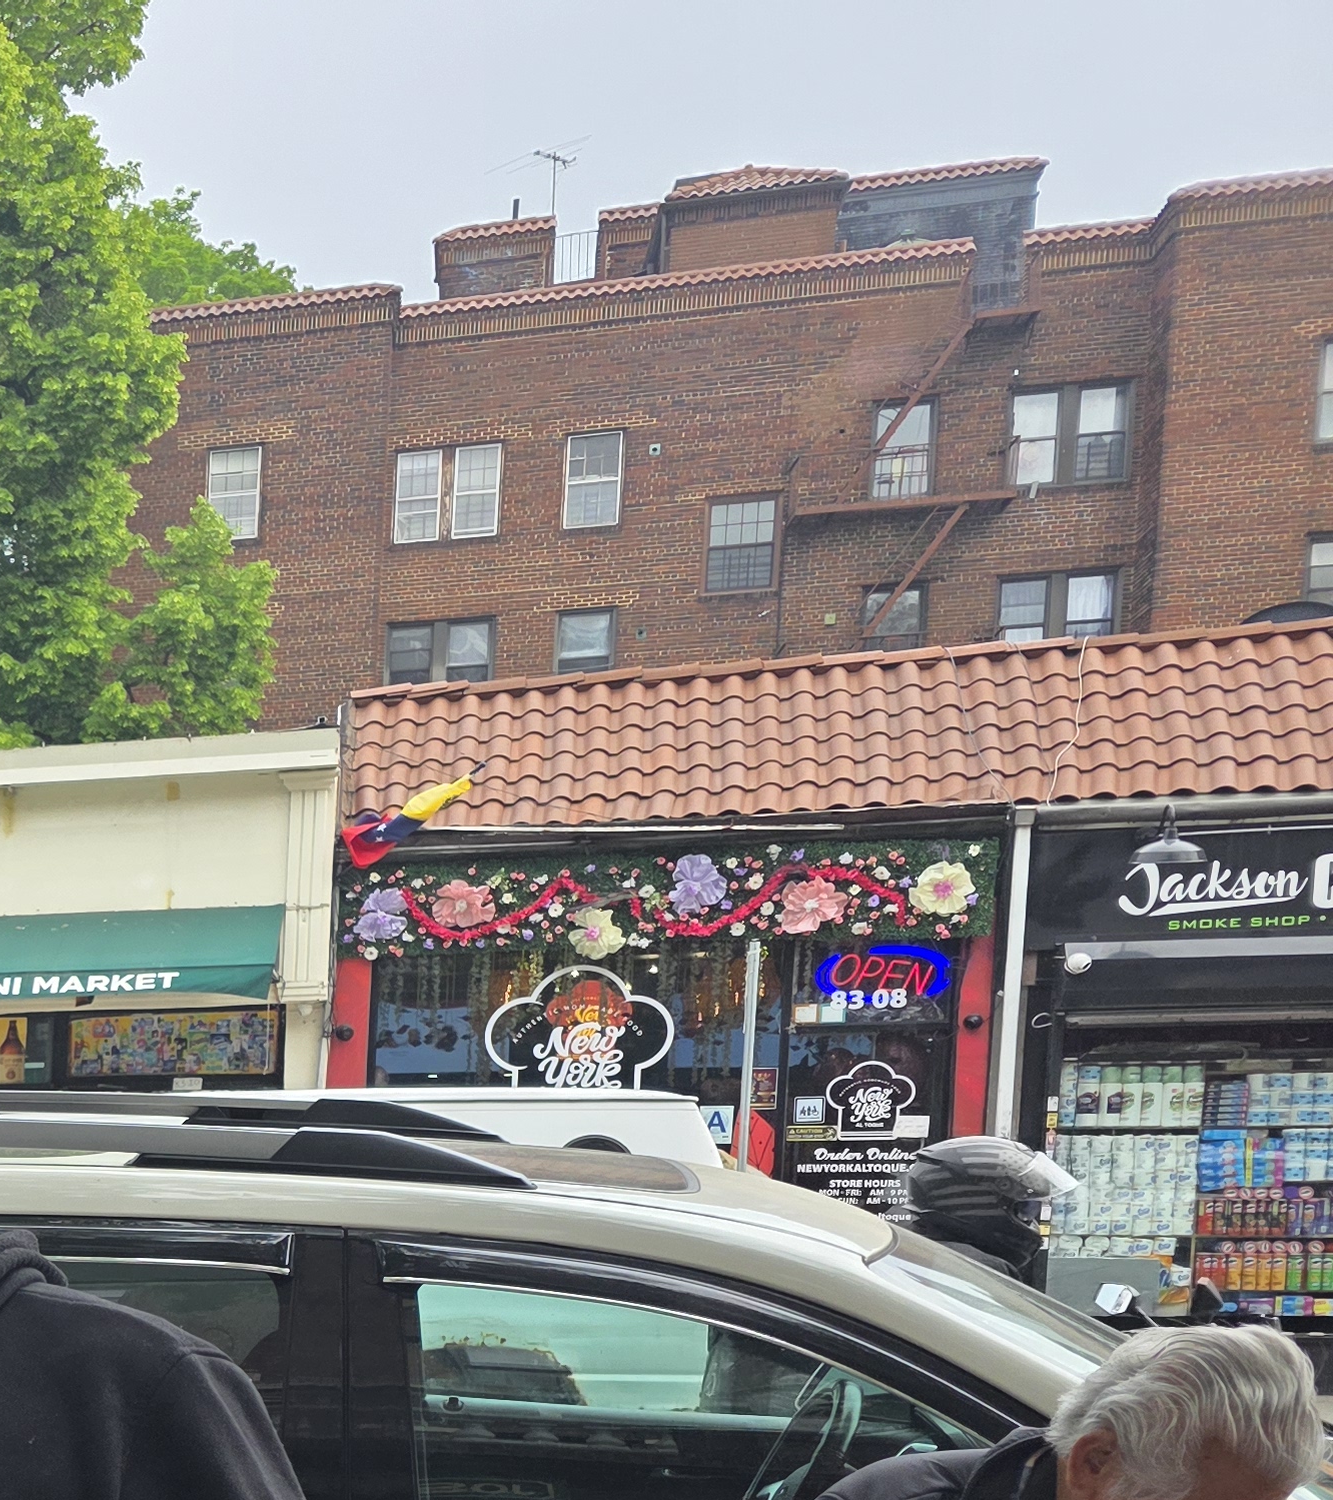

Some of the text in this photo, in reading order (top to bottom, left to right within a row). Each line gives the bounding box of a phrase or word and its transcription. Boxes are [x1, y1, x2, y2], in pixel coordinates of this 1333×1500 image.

[1118, 860, 1309, 916] Jackson
[1168, 915, 1311, 931] SMOKE SHOP
[32, 971, 181, 996] MARKET
[832, 953, 935, 997] OPEN
[533, 1022, 626, 1060] New
[849, 1086, 894, 1105] New
[707, 1110, 727, 1134] A
[850, 1098, 893, 1123] York
[814, 1148, 864, 1161] Order
[829, 1179, 901, 1188] STORE HOURS
